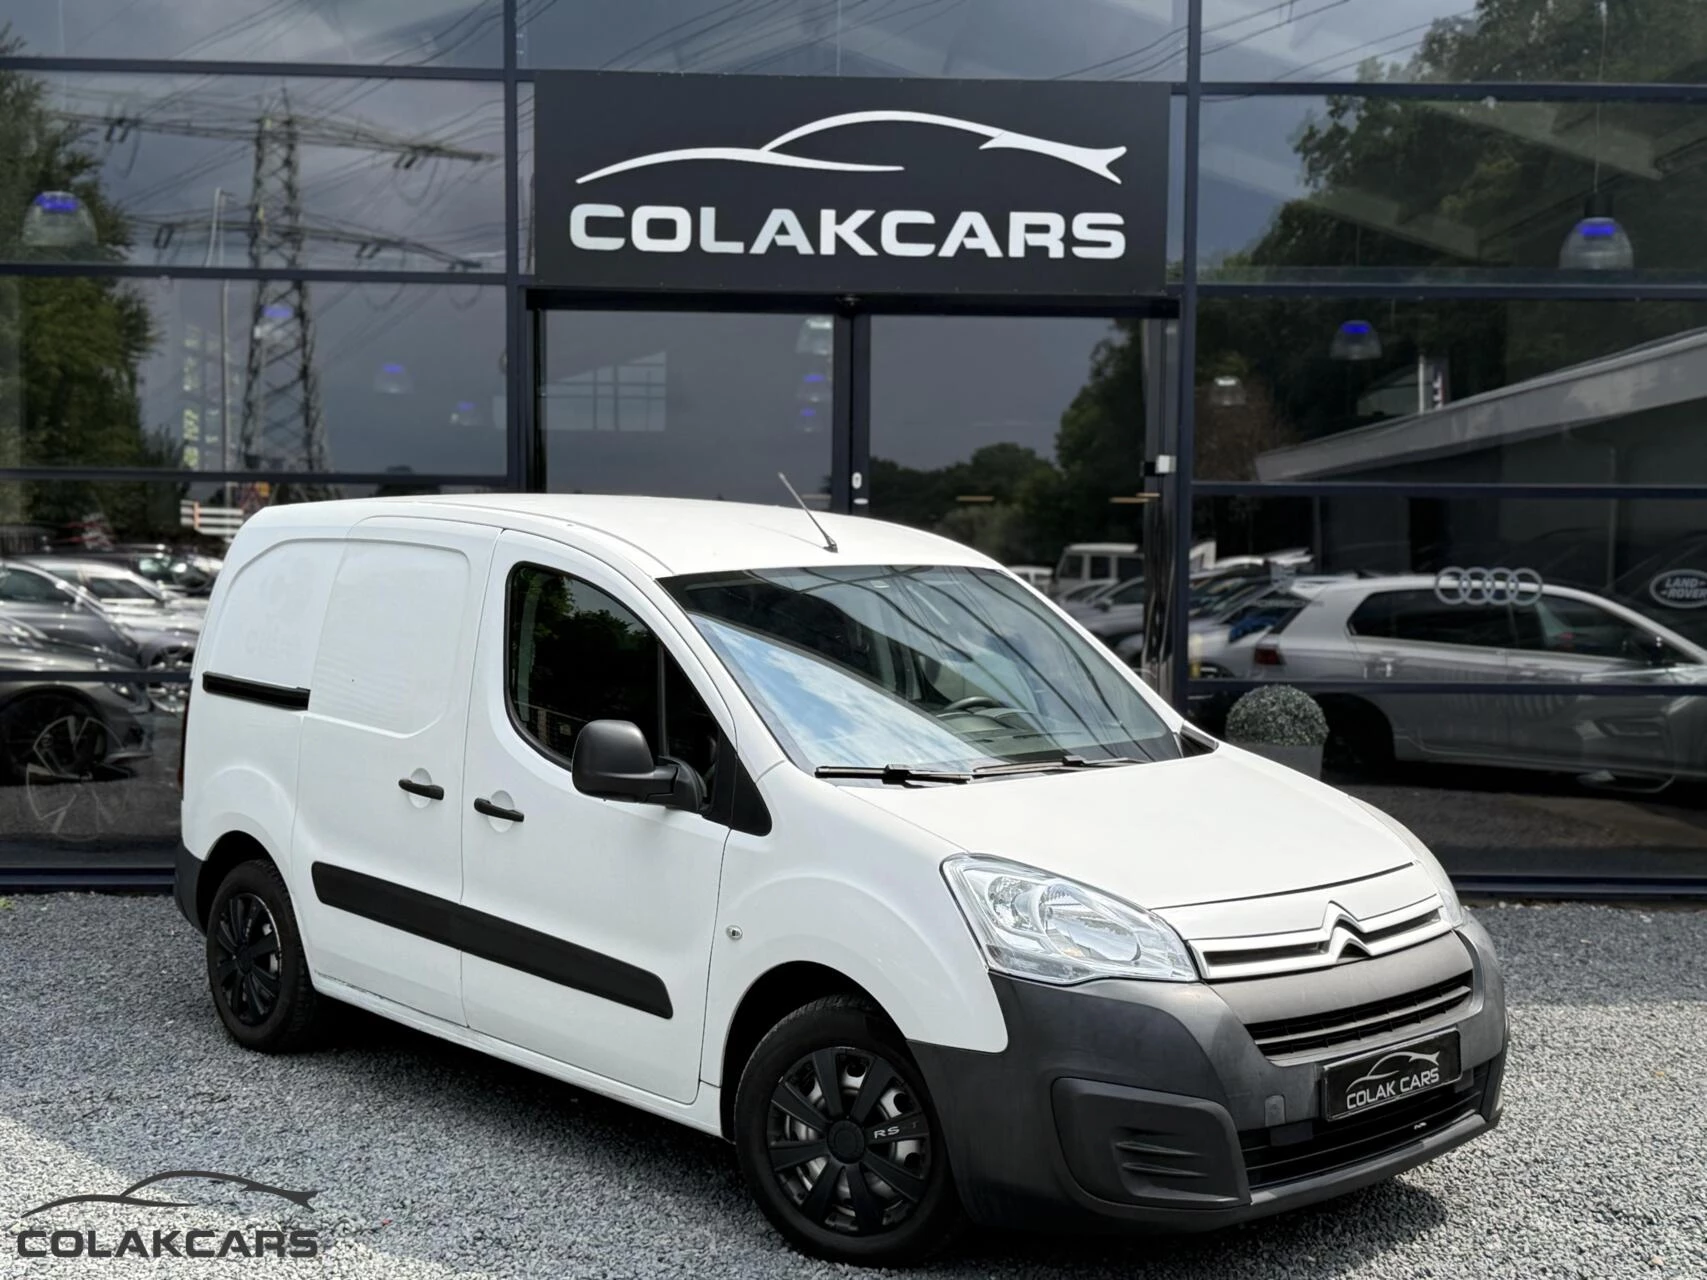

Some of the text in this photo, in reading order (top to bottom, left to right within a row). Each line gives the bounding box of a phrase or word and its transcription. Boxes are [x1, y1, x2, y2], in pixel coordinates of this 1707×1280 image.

[569, 203, 1126, 259] COLAKCARS
[1346, 1067, 1439, 1109] COLAK CARS
[873, 1126, 900, 1139] RS
